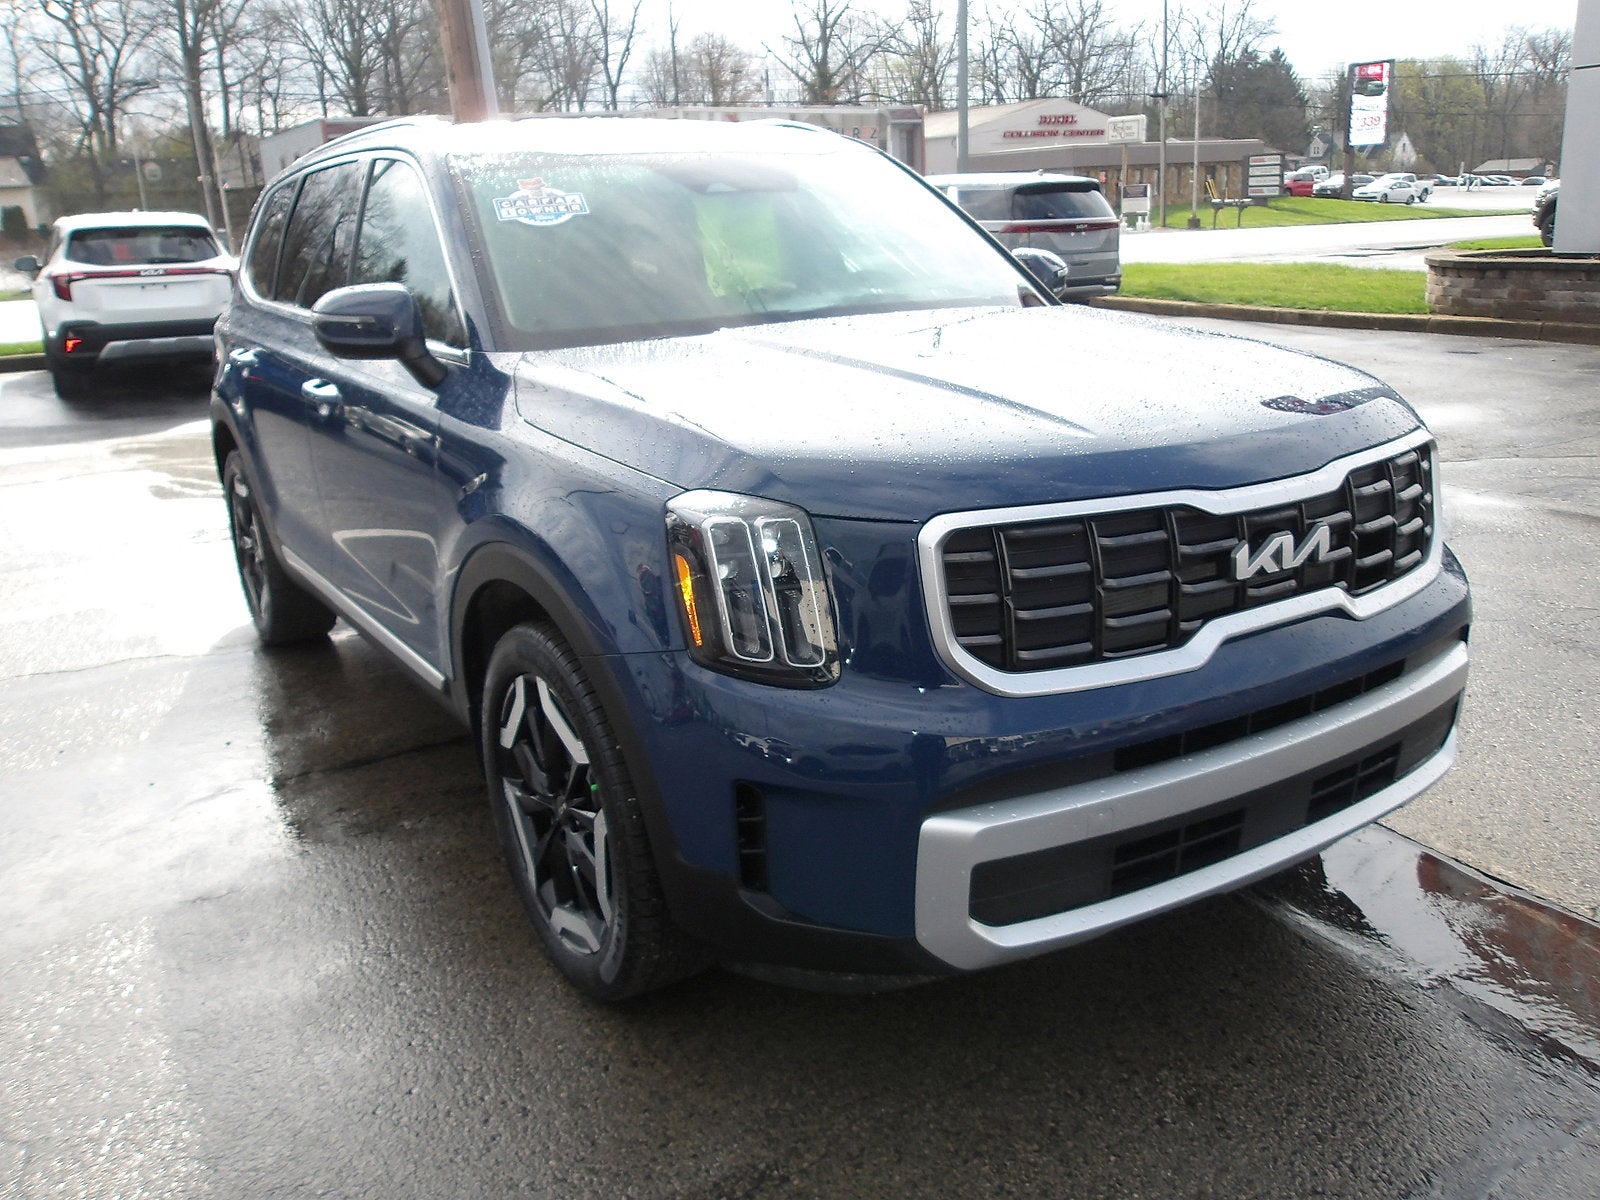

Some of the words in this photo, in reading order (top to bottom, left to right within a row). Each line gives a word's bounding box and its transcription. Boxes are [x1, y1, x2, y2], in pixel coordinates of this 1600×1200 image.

[1003, 129, 1059, 138] COLLISION
[1063, 128, 1105, 137] CENTER
[1231, 521, 1330, 580] KIA
